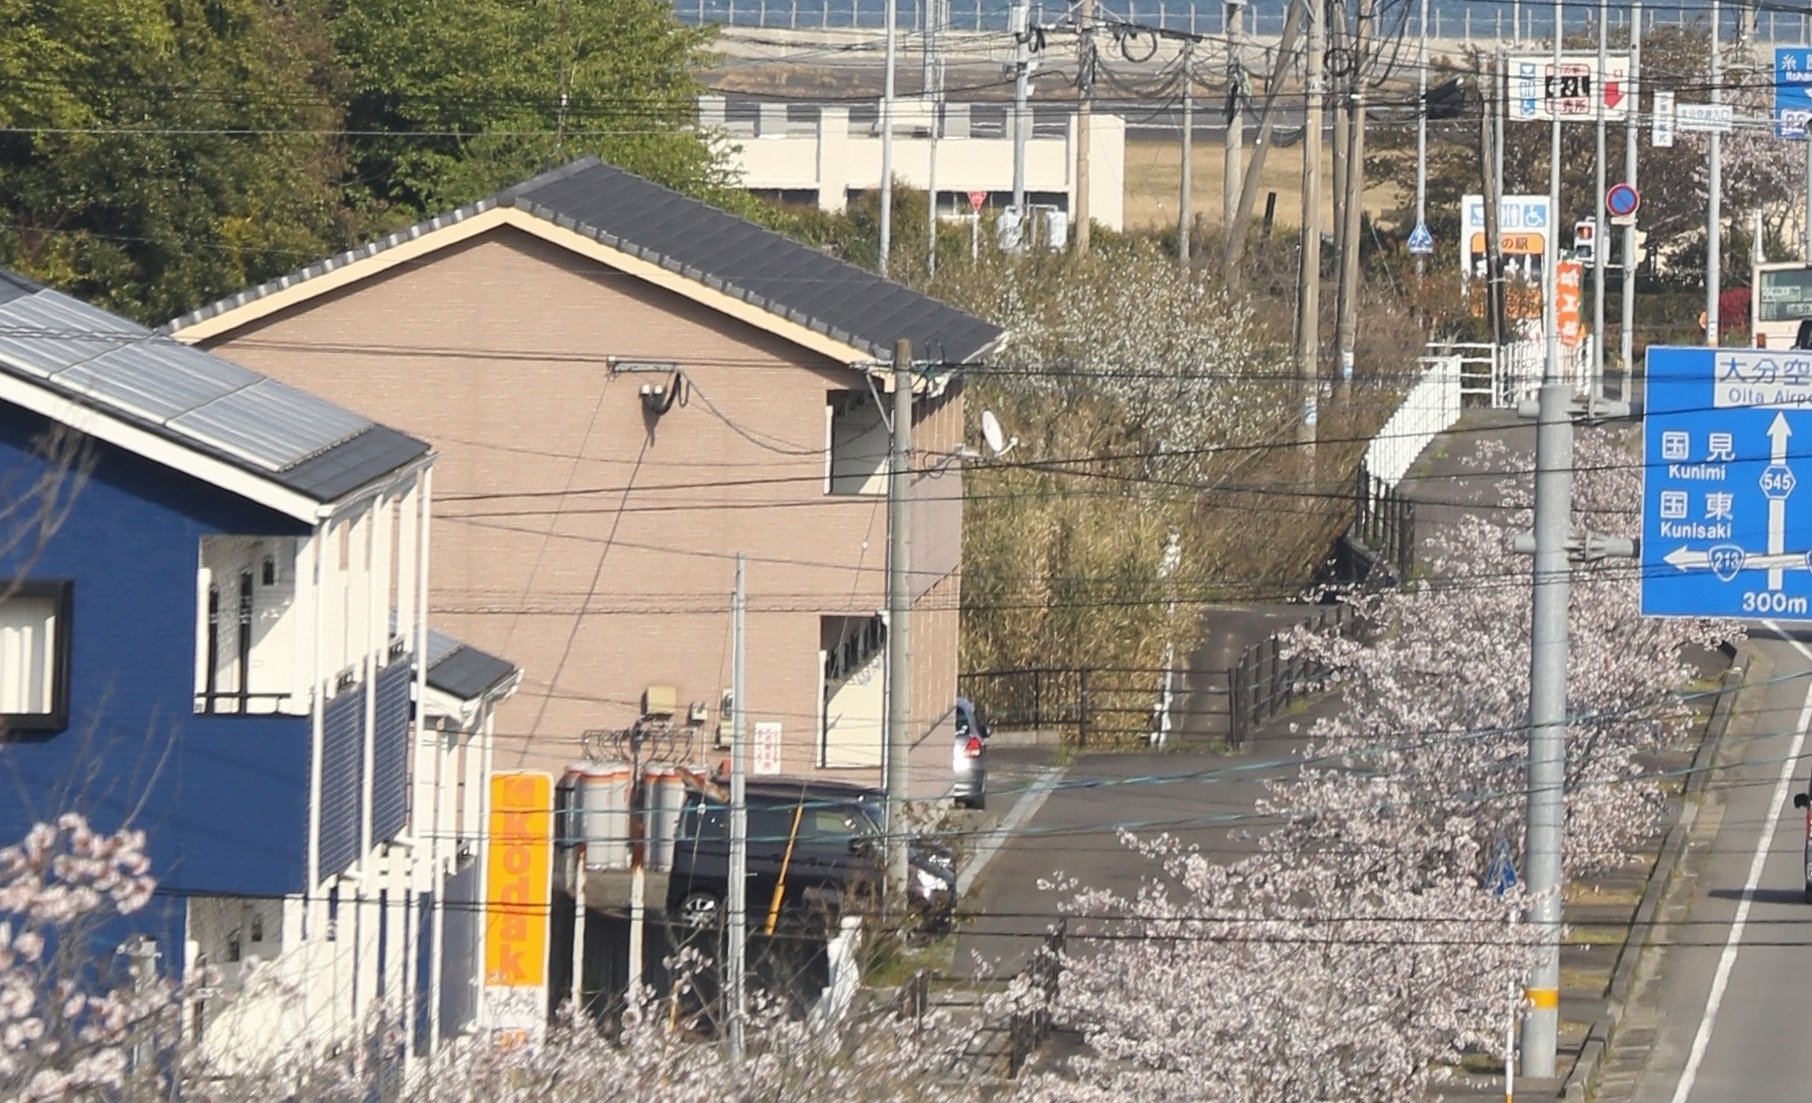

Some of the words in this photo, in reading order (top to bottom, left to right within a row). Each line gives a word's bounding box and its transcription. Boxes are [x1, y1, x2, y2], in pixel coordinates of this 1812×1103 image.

[1728, 389, 1764, 405] Oita
[1662, 431, 1735, 462] 国見
[1669, 464, 1726, 481] Kunimi
[1764, 473, 1790, 490] 545
[1660, 491, 1734, 520] 国東
[1660, 522, 1731, 539] Kunisaki
[1714, 552, 1739, 568] 213
[1743, 592, 1807, 614] 300m
[499, 812, 533, 980] Kodak
